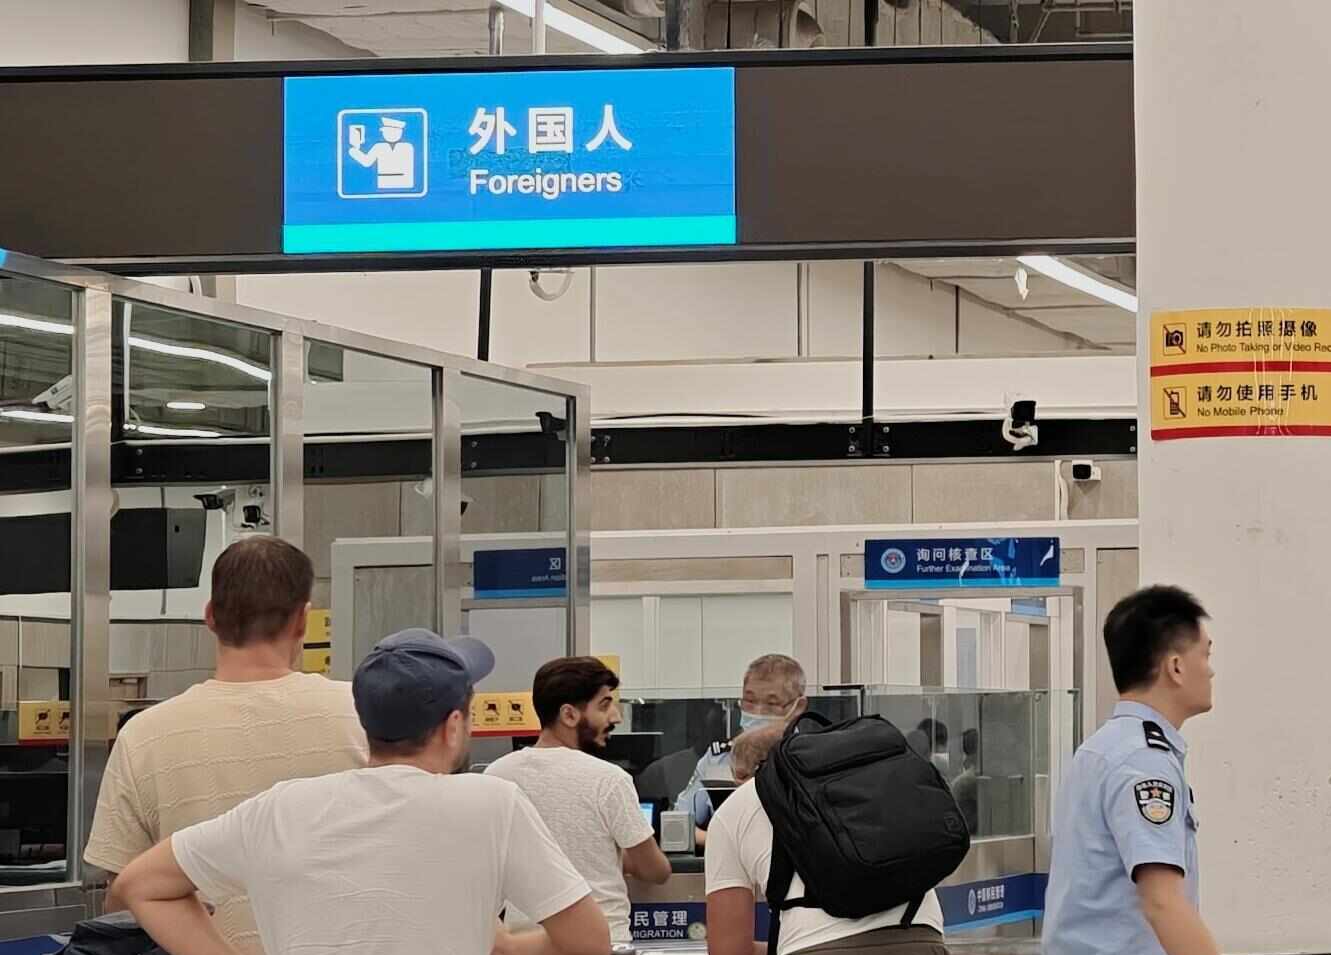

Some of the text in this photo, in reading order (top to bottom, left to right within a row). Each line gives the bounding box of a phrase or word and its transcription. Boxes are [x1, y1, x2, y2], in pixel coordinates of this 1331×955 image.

[468, 103, 633, 155] 外国人
[469, 168, 622, 200] Foreigners
[1196, 320, 1318, 339] 请勿拍照摄像
[1196, 343, 1209, 353] No
[1210, 343, 1238, 353] Photo
[1240, 342, 1270, 356] Taking
[1284, 343, 1311, 353] Video
[1196, 384, 1318, 402] 请勿使用手机
[1197, 407, 1211, 417] No
[1213, 406, 1246, 417] Mobile
[916, 547, 994, 562] 询问核查区
[945, 563, 991, 573] Exanation
[633, 910, 688, 927] 民管理
